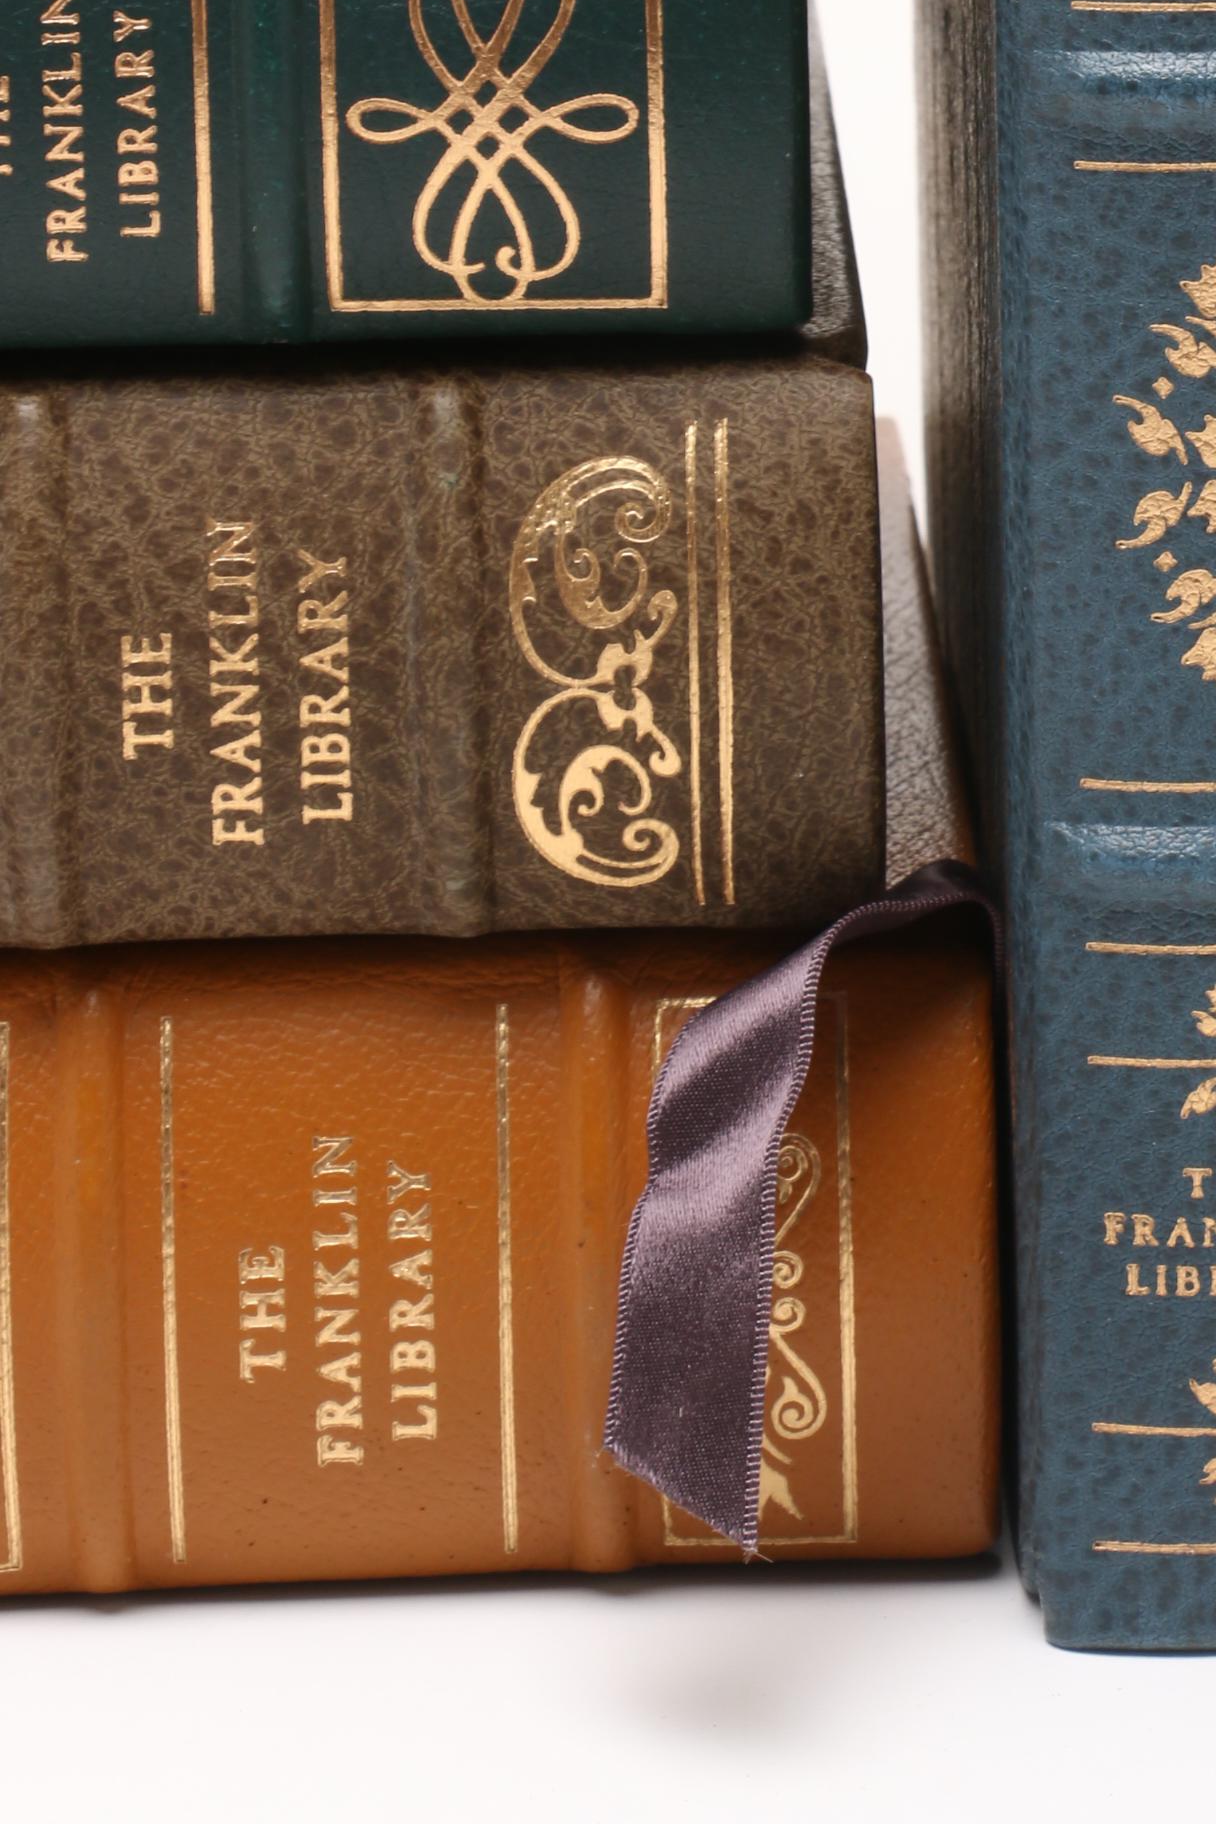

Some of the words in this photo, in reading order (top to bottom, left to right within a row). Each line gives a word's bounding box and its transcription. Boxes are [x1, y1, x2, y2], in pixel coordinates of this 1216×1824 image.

[113, 11, 161, 238] LIBRARY
[121, 632, 175, 761] THE
[205, 518, 265, 846] FRANKLIN
[297, 549, 354, 825] LIBRARY
[239, 1246, 287, 1384] THE
[312, 1136, 363, 1466] FRANKLIN
[388, 1161, 438, 1441] LIBRARY
